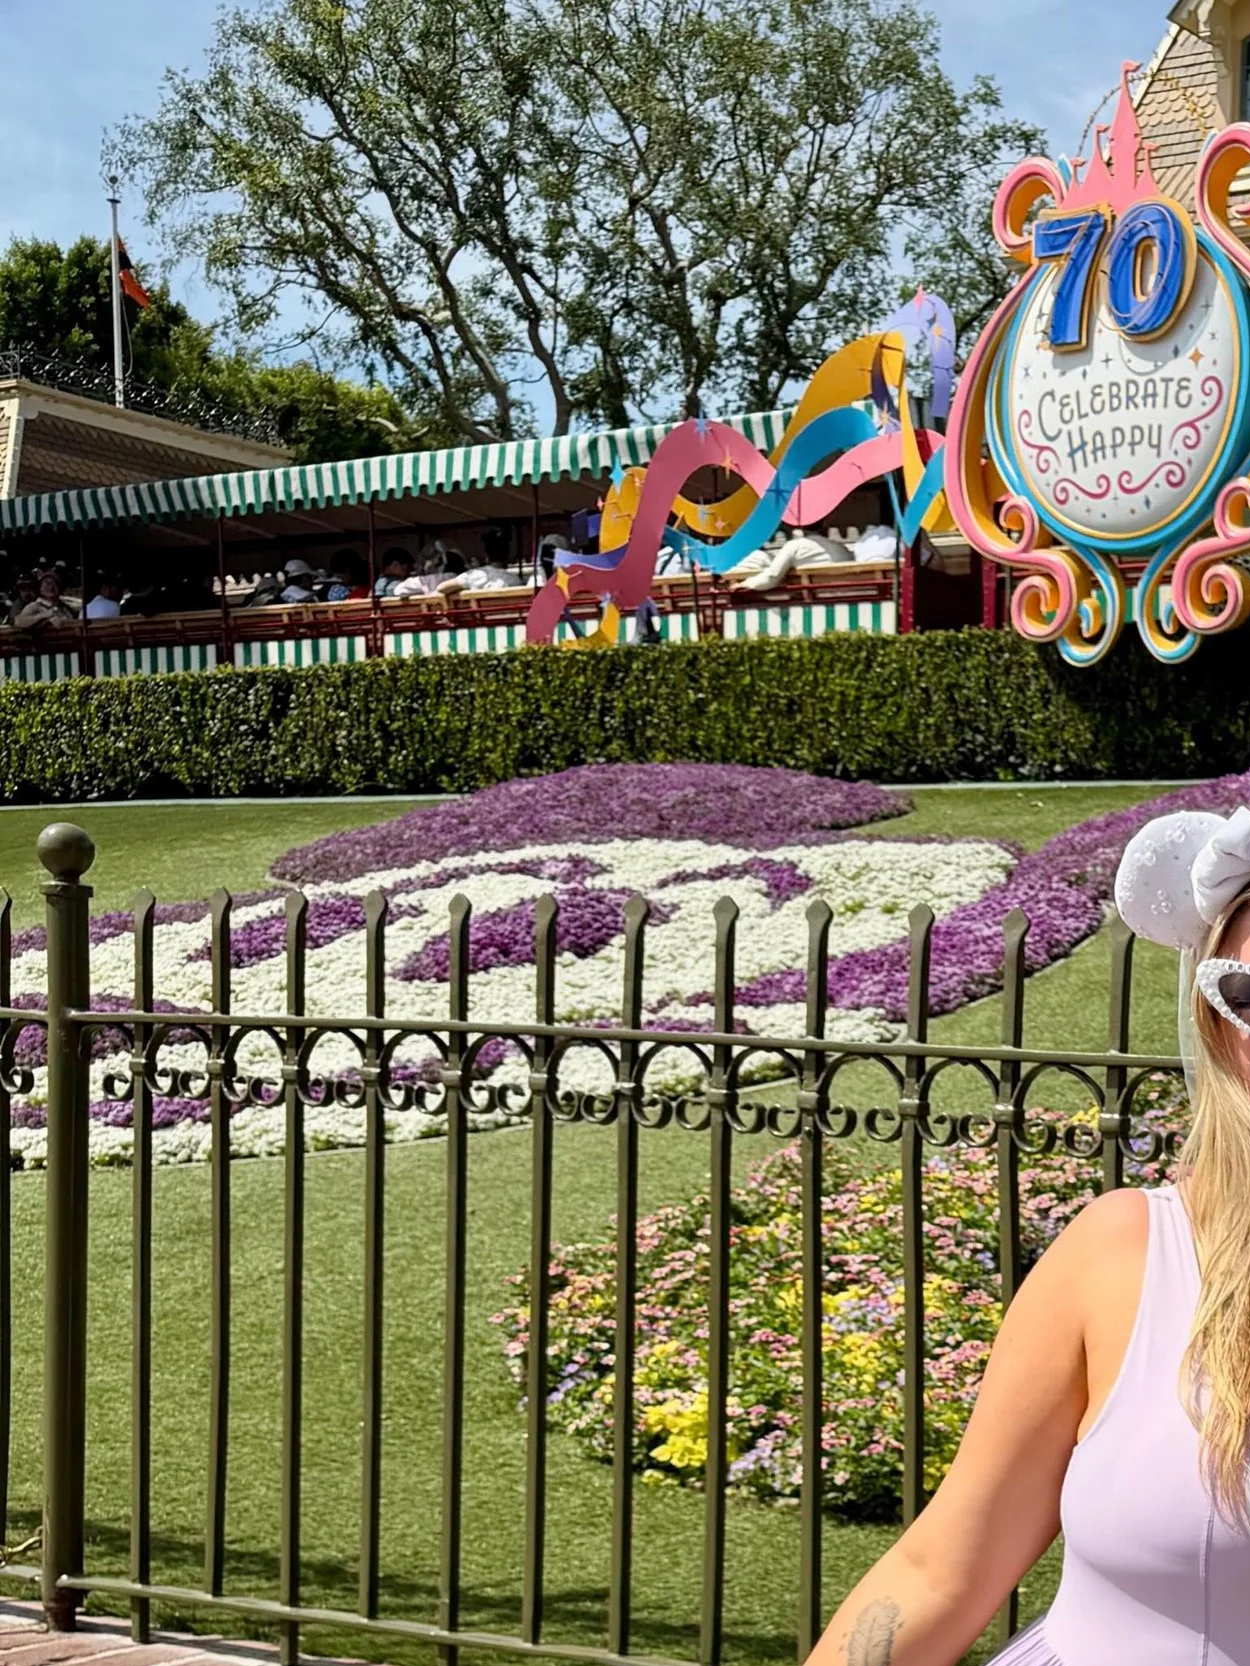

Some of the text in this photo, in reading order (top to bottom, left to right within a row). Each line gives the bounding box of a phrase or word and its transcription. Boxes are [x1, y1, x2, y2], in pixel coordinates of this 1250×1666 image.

[1032, 202, 1190, 349] 70
[1038, 377, 1193, 442] CELEBRATE
[1066, 424, 1163, 474] HAPPY
